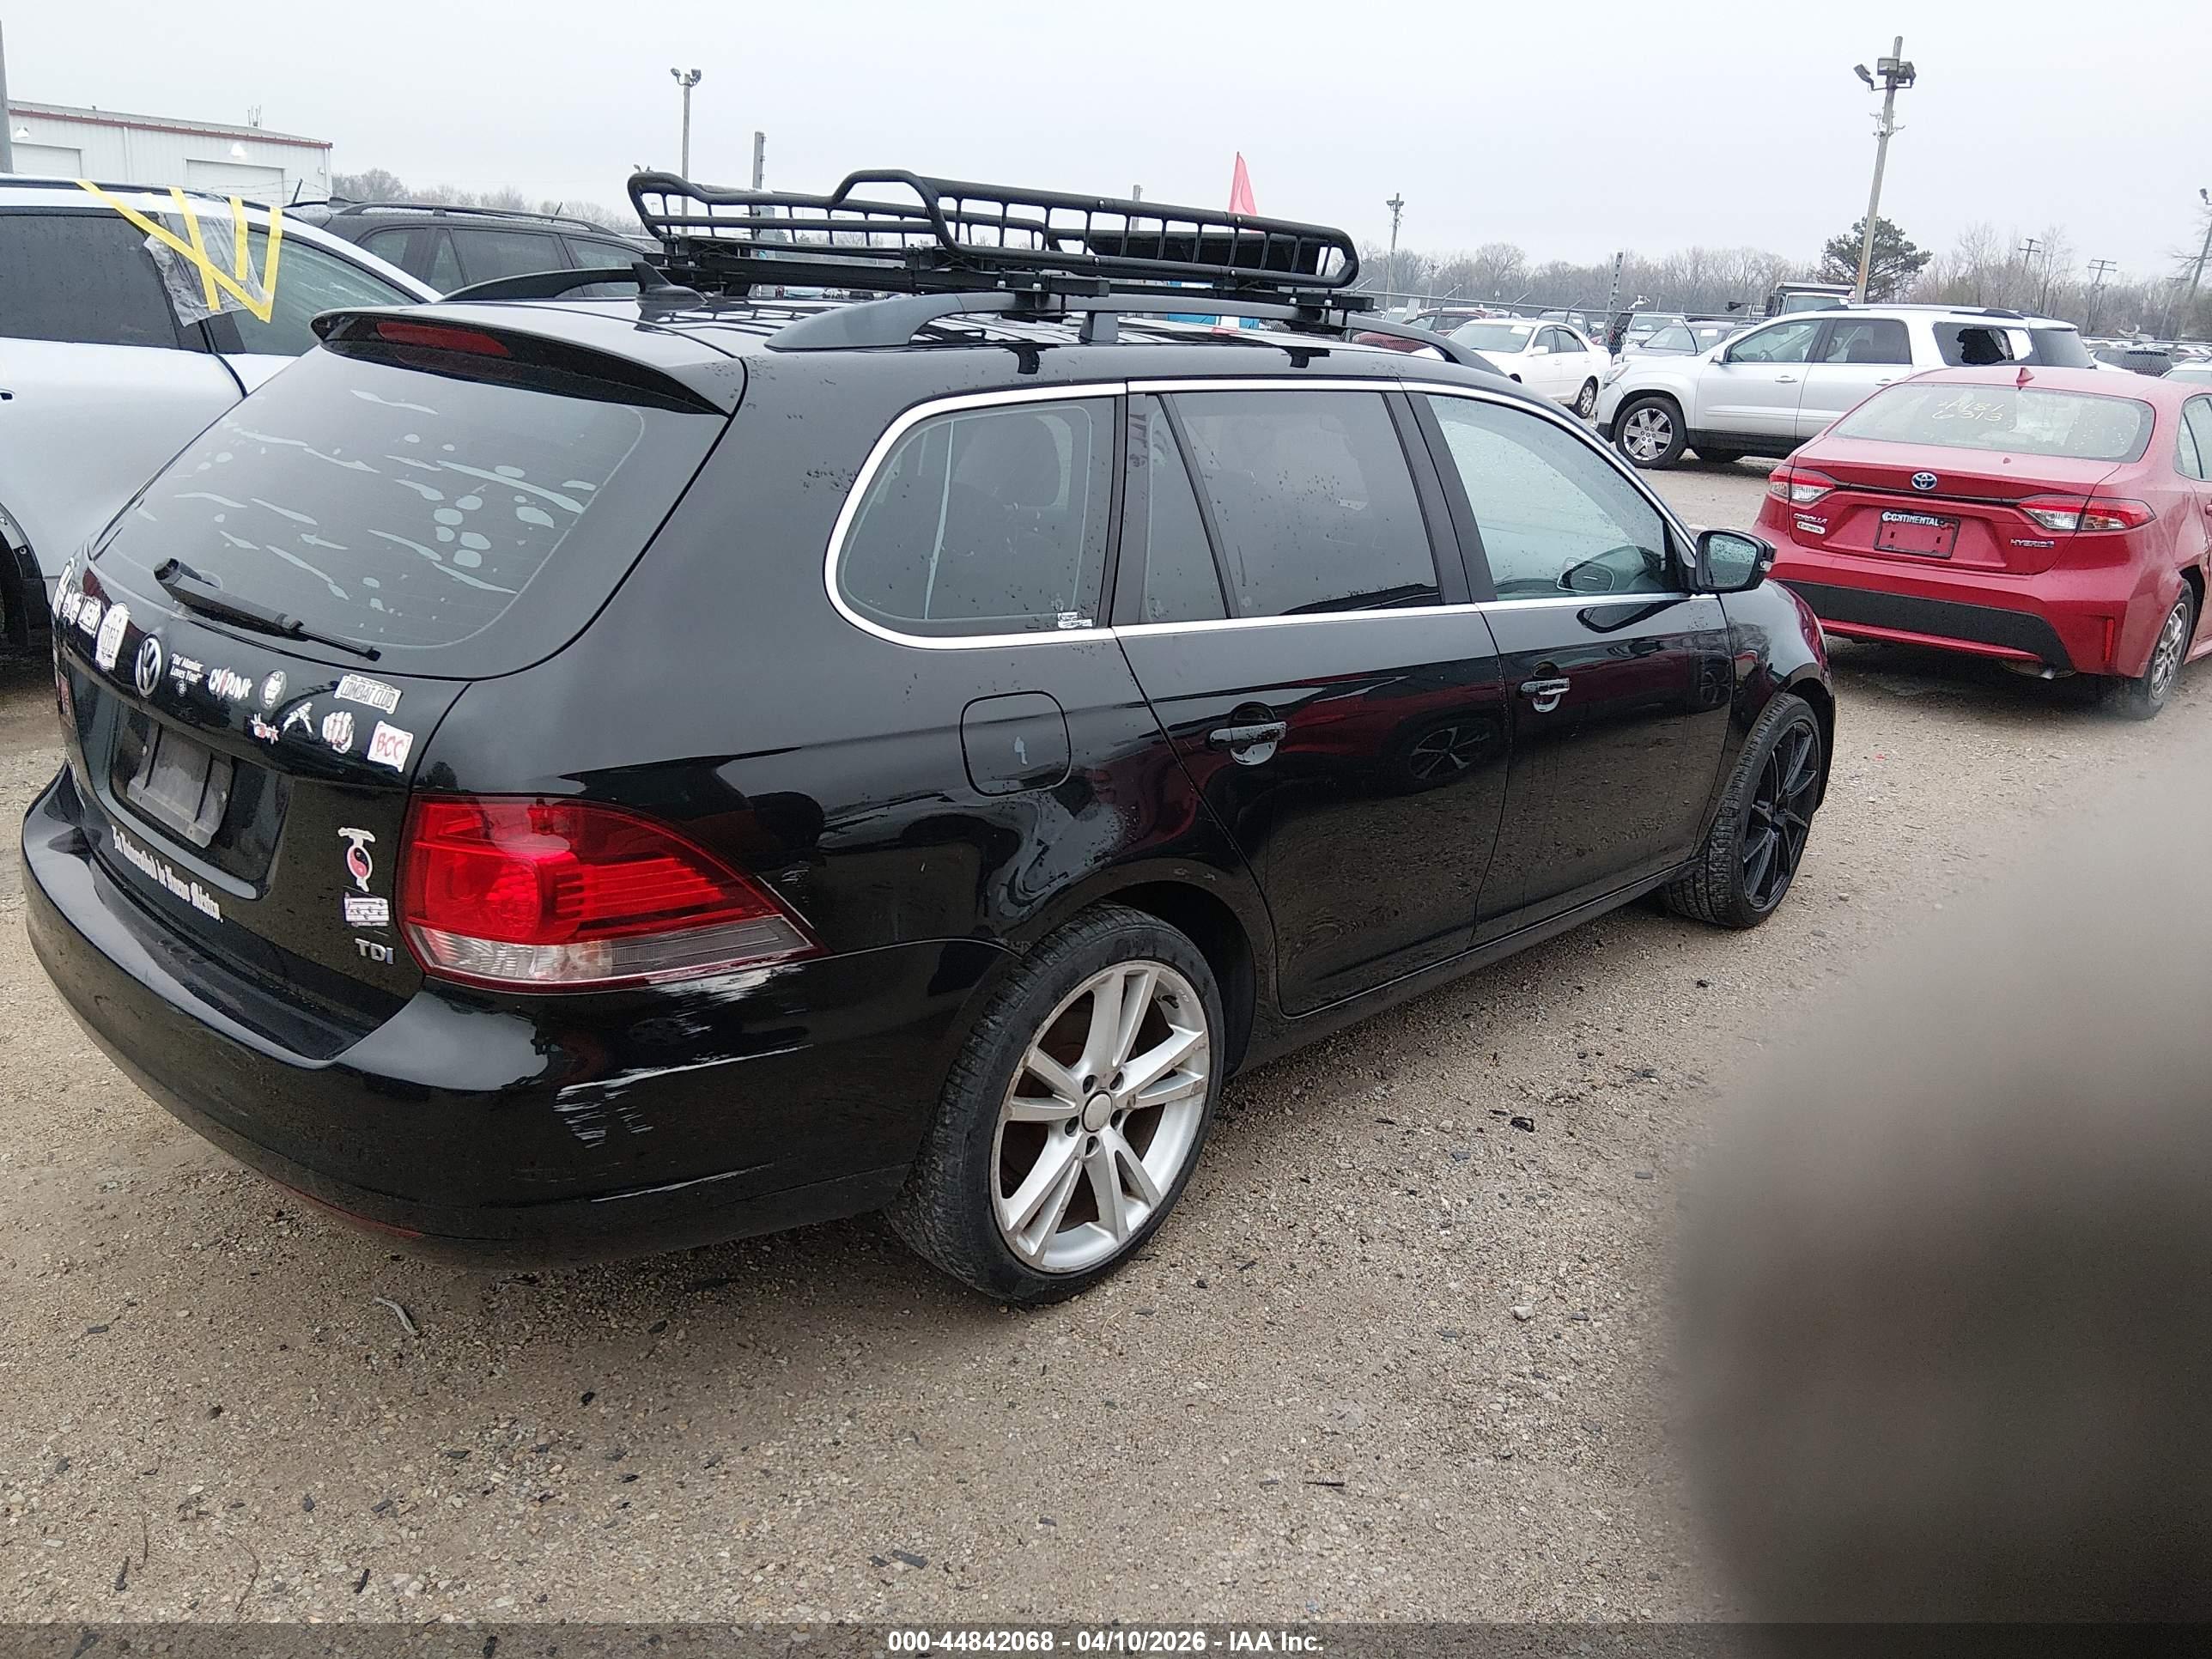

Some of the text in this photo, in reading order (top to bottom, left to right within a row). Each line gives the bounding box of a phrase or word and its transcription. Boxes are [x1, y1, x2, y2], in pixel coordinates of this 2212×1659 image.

[1793, 513, 1828, 524] COROLLA
[2010, 538, 2049, 548] HYBRID
[377, 732, 404, 760] BCC
[355, 938, 395, 964] TDI
